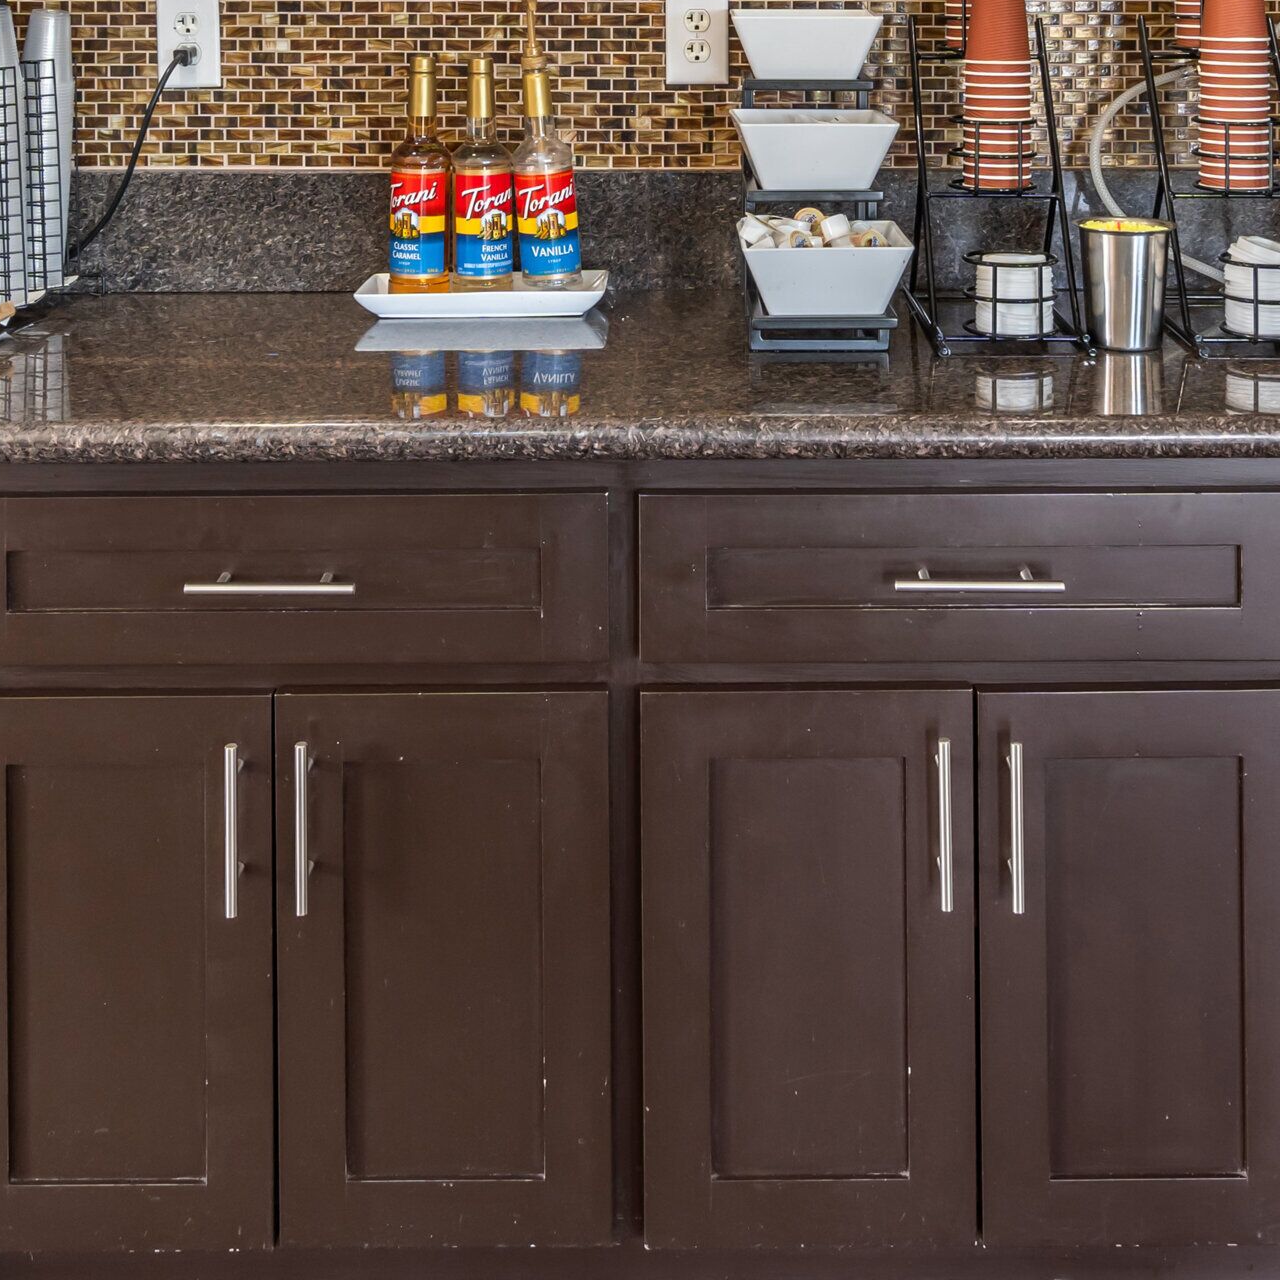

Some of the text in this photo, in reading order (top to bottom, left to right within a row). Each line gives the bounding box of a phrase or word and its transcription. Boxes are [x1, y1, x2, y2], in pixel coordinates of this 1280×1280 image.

[390, 182, 438, 214] Torani
[461, 184, 512, 220] Toran
[519, 178, 573, 220] Torani
[394, 242, 418, 251] CLASSIC
[482, 243, 507, 252] FRENCH
[532, 244, 574, 258] VANILLA
[393, 251, 421, 260] CARAMEL
[481, 252, 508, 261] VANILLA
